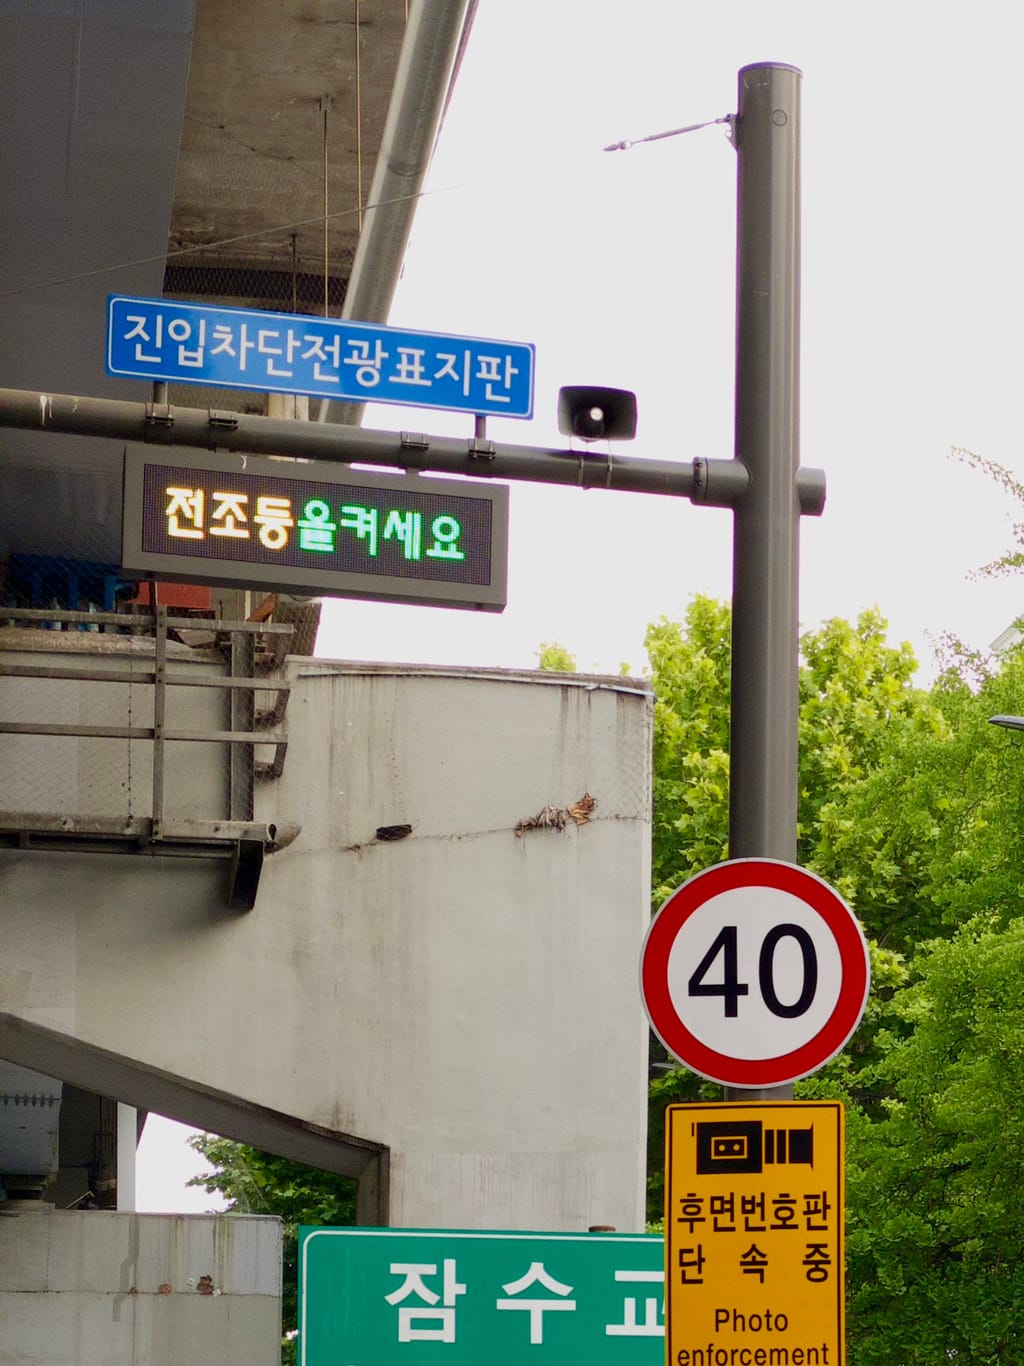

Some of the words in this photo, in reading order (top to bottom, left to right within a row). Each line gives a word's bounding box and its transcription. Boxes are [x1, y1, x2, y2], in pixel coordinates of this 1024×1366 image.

[123, 314, 519, 403] 진입차단전광표지판
[687, 922, 819, 1019] 40
[677, 1190, 831, 1234] 후면번호판
[714, 1308, 789, 1333] Photo
